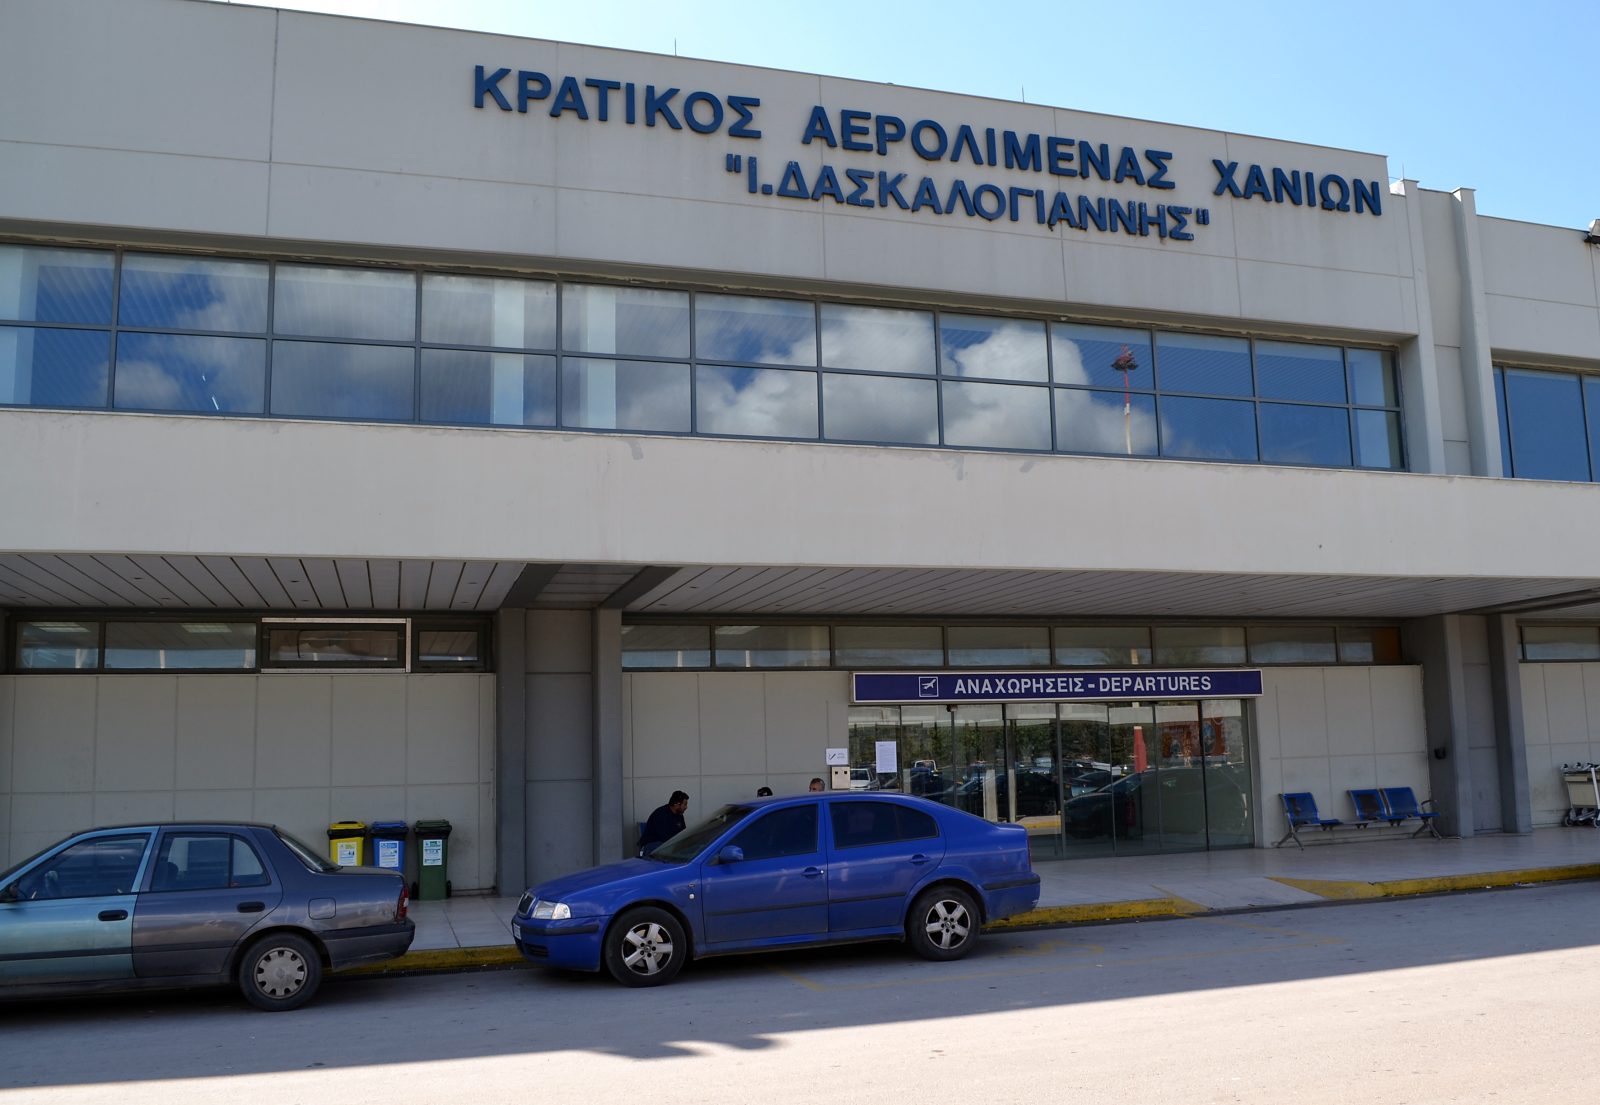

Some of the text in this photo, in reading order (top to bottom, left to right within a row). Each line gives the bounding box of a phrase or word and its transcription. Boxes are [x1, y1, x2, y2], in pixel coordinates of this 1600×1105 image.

[474, 65, 1382, 216] ΚΡΑΤΙΚΟΣ ΑΕΡΟΛΙΜΕΝΑΣ ΧΑΝΙΩΝ
[954, 677, 1085, 694] ΑΝΑΧΩΡΗΣΕΙΣ
[1099, 675, 1212, 692] DEPARTURES
